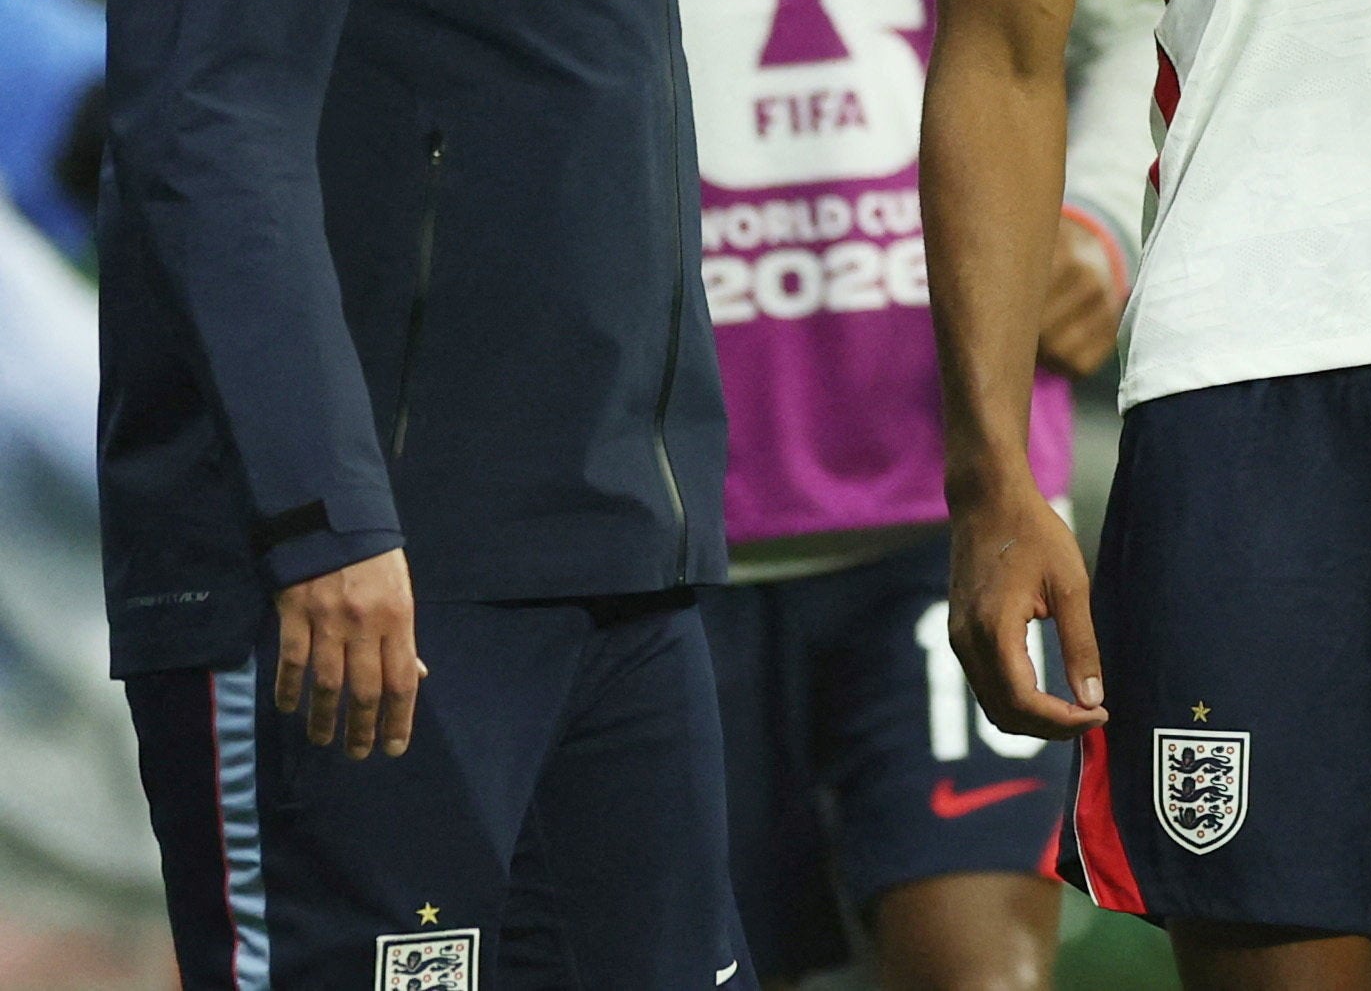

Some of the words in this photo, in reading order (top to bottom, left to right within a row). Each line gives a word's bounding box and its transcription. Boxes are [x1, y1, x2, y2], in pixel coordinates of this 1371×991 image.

[754, 89, 868, 137] FIFA
[855, 189, 920, 237] CU
[701, 237, 930, 326] 2026
